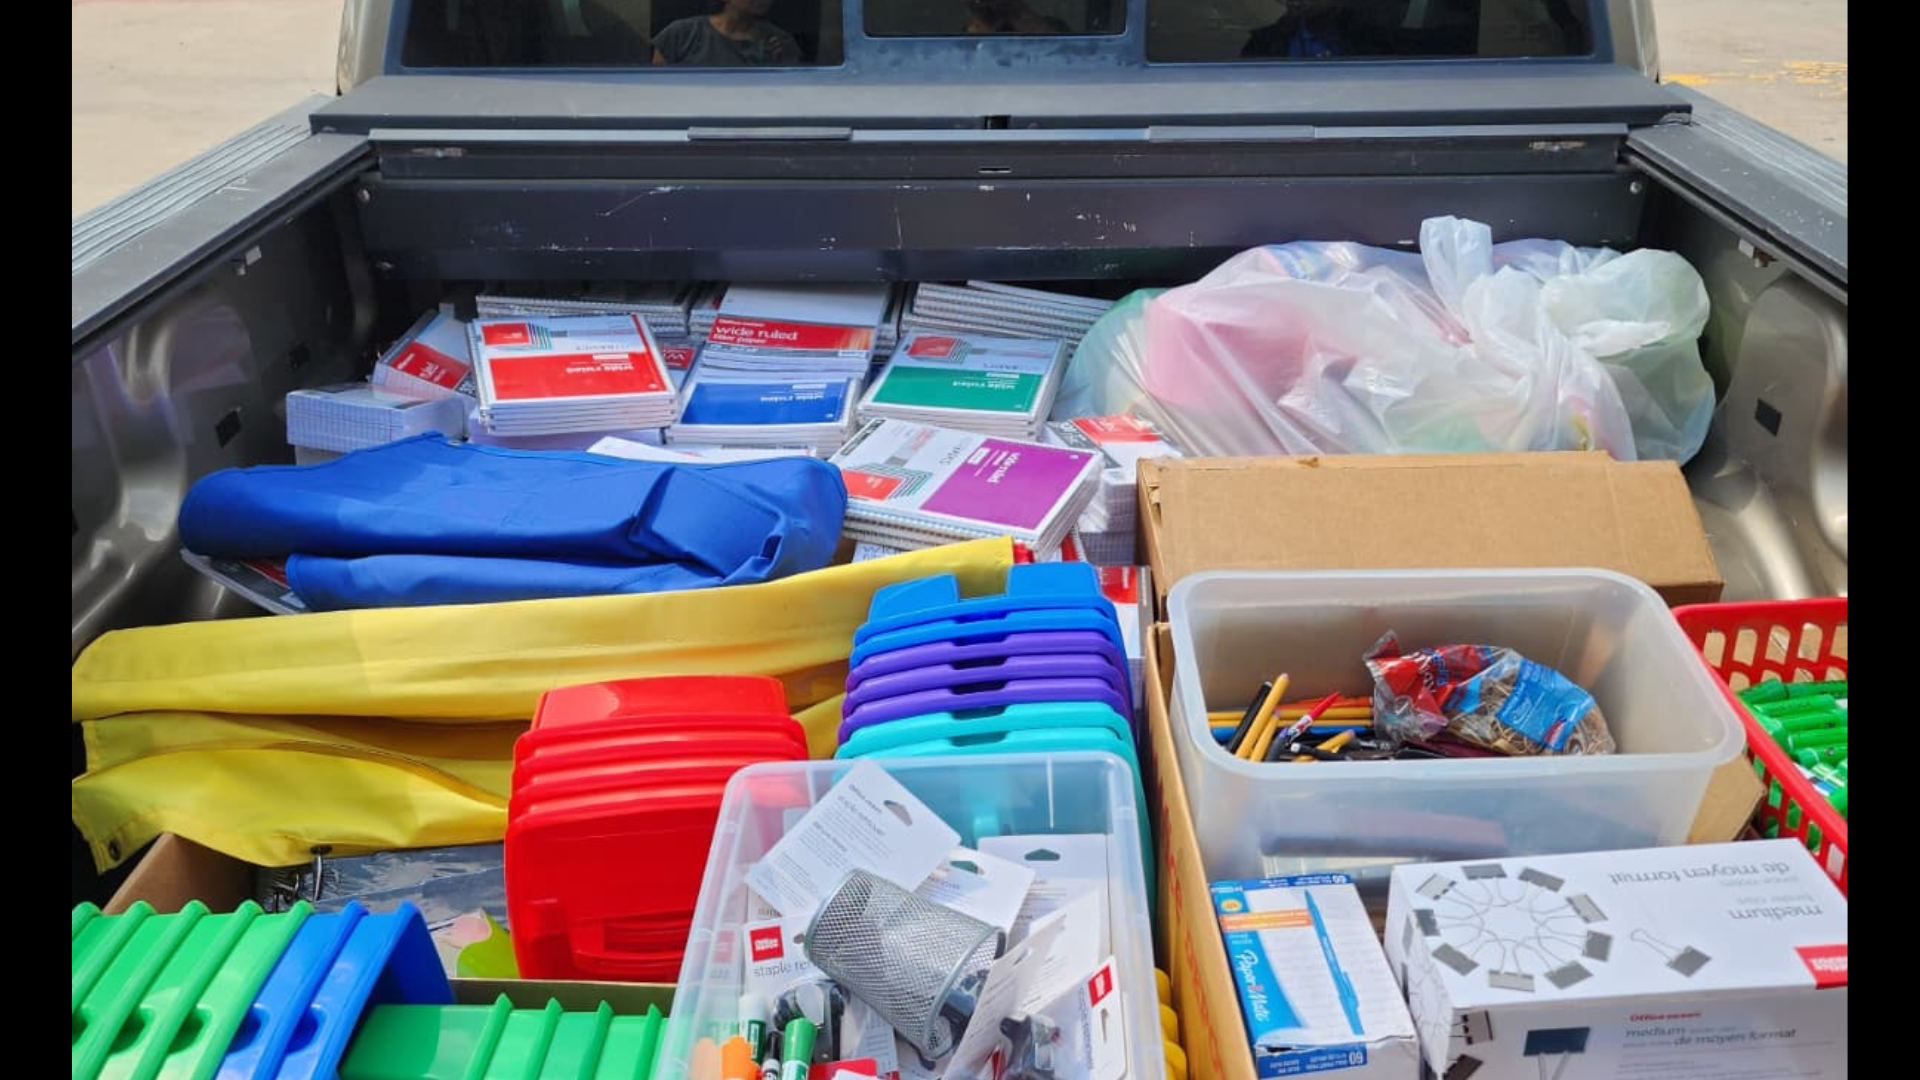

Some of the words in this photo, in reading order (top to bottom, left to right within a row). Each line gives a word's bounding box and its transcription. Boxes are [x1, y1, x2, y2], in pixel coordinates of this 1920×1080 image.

[714, 326, 754, 337] wide
[757, 329, 799, 341] ruled
[1681, 864, 1760, 880] moyen
[1760, 861, 1790, 875] de
[1607, 869, 1681, 886] format
[1728, 904, 1824, 921] medium
[752, 960, 791, 978] staple
[1234, 948, 1260, 987] Paper
[1248, 989, 1272, 1022] Mate
[1625, 1026, 1686, 1038] medium
[1673, 1035, 1692, 1047] de
[1694, 1031, 1746, 1047] moyen
[1748, 1028, 1798, 1041] format
